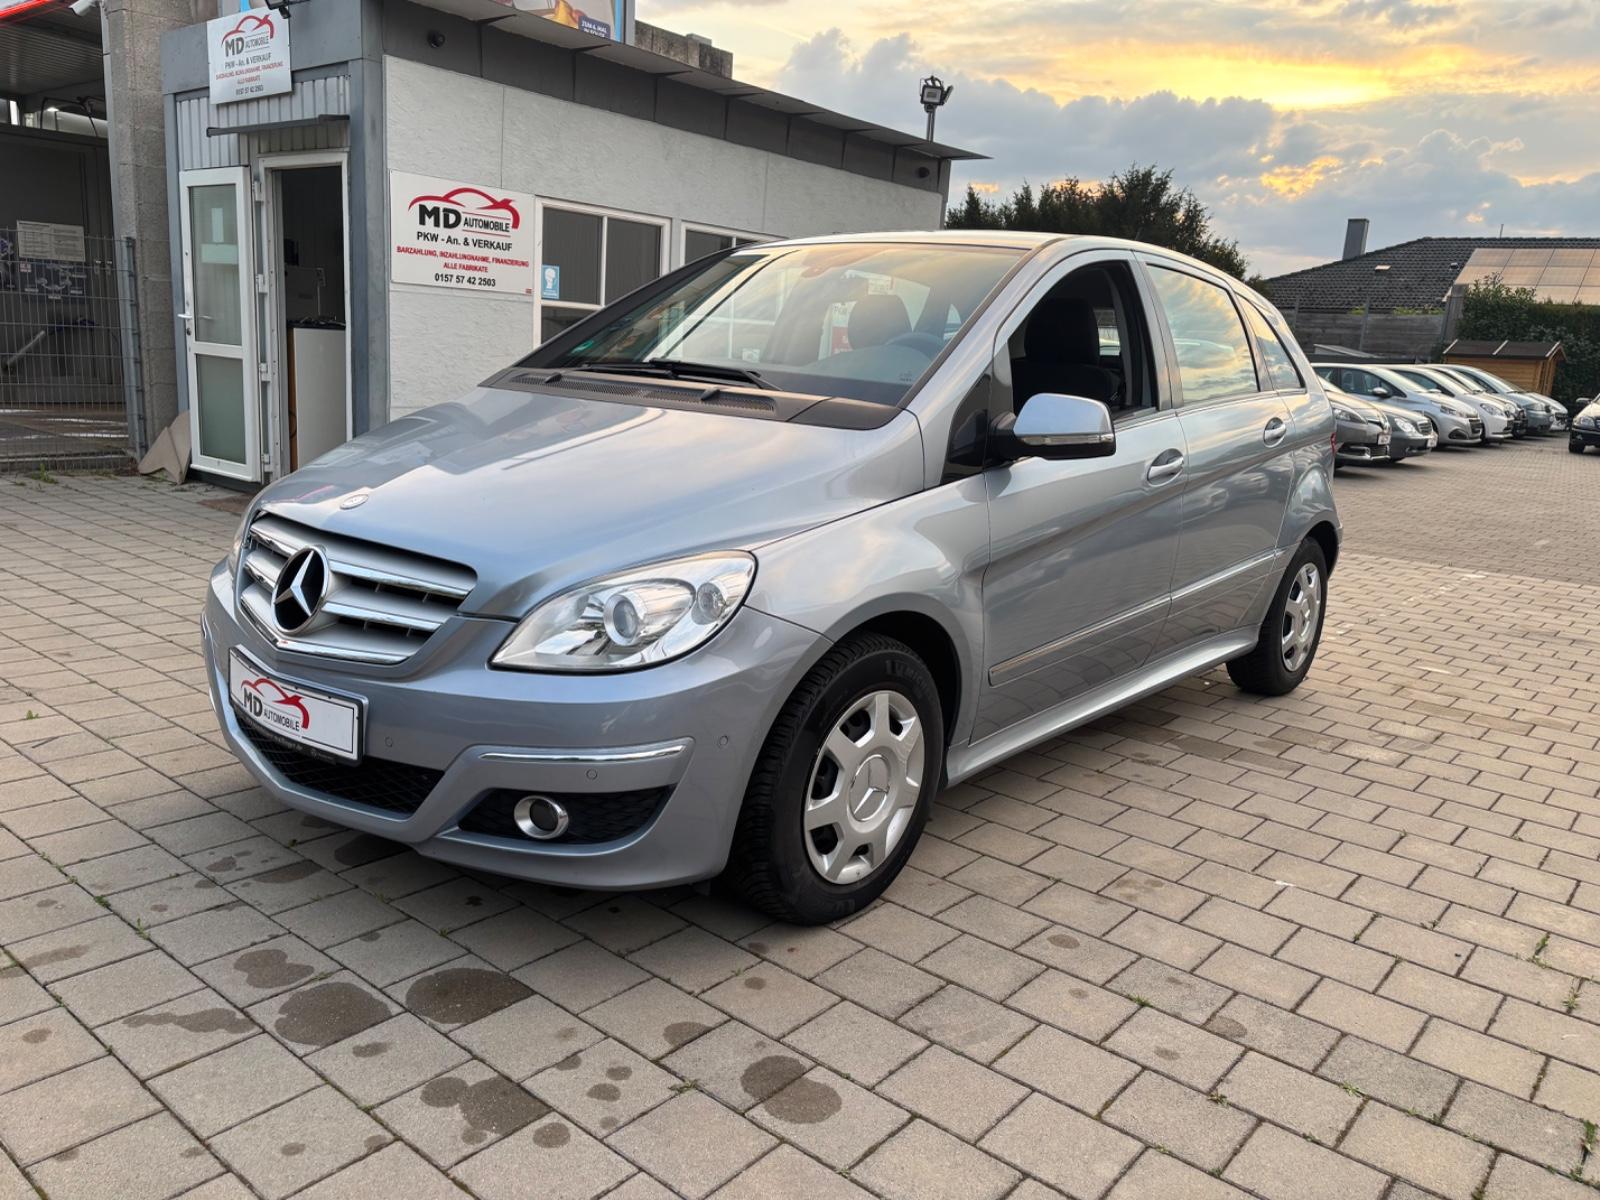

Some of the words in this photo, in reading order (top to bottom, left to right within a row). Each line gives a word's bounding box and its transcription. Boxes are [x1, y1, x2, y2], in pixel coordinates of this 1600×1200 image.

[225, 37, 244, 57] MD
[245, 36, 269, 48] AUTOMOBILE
[419, 204, 462, 229] MD
[463, 217, 510, 233] AUTOMOBILE
[417, 231, 438, 242] PKW
[446, 235, 461, 246] An.
[463, 237, 470, 246] &
[472, 239, 512, 251] VERKAUF
[397, 246, 438, 258] BARZAHLUNG,
[443, 262, 458, 270] ALLE
[459, 263, 489, 273] FABRIKATE
[434, 272, 454, 283] 0157
[455, 275, 465, 284] 57
[466, 276, 477, 285] 42
[478, 277, 496, 287] 2503
[243, 687, 263, 717] MD
[263, 709, 300, 730] AUTOMOBILE
